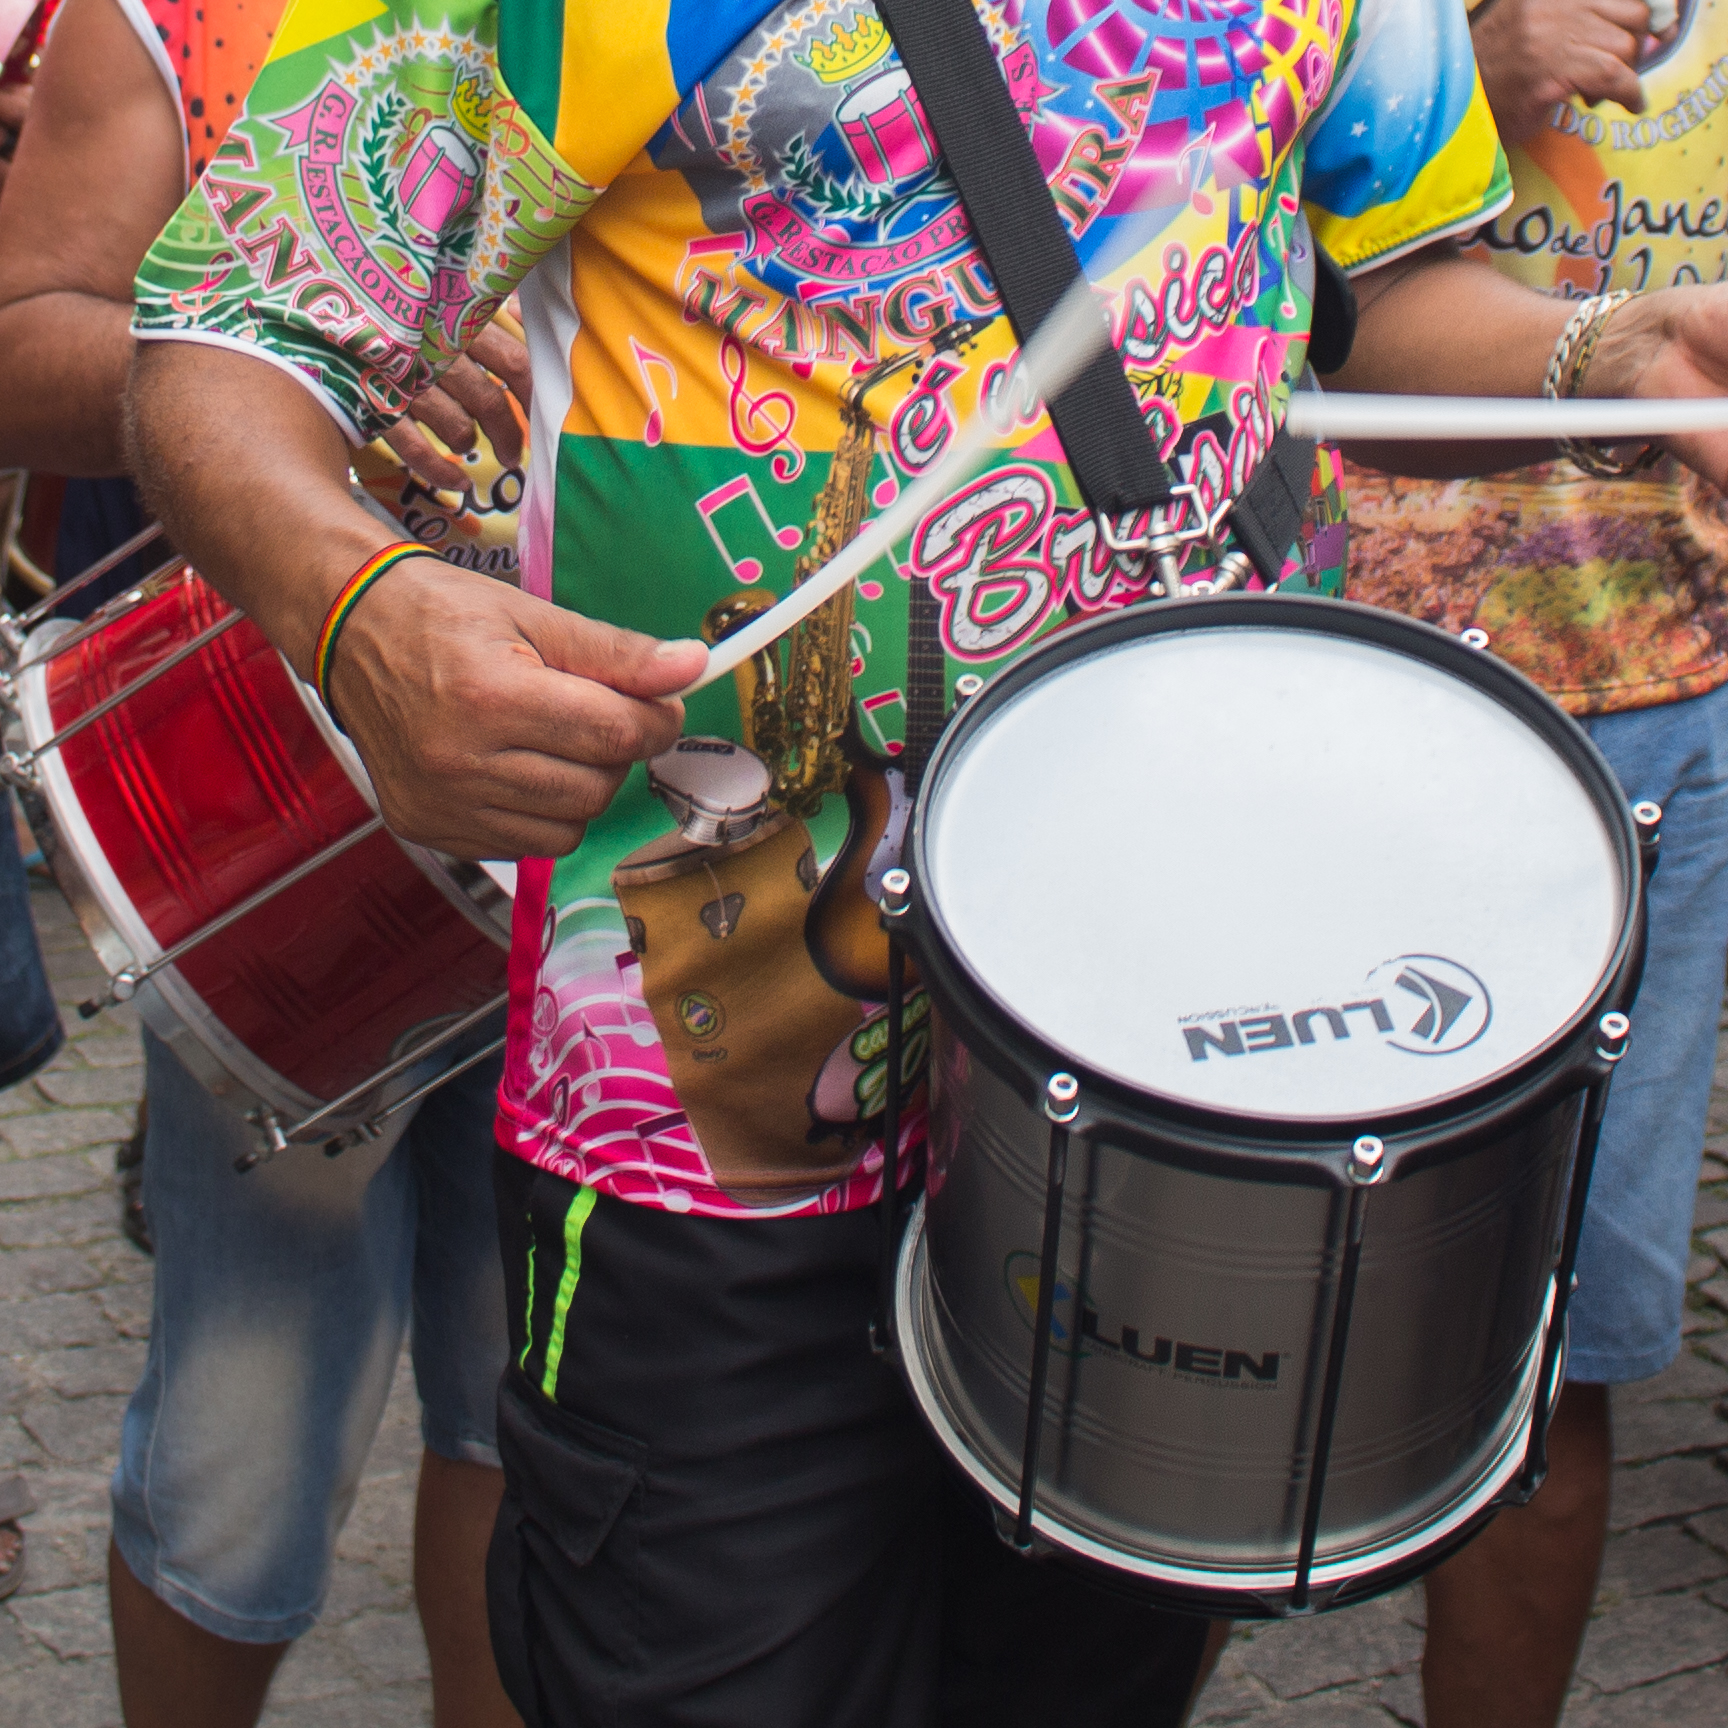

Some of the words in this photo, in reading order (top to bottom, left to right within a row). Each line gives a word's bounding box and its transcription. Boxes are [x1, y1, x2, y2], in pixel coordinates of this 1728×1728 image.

[1550, 101, 1605, 146] DO
[306, 165, 381, 291] ESTAÇÃO
[686, 68, 1162, 364] MANGUIRA
[788, 240, 923, 278] ESTAÇÃO
[894, 362, 964, 474] é
[1182, 998, 1395, 1062] LUEN
[1081, 1308, 1280, 1381] LUEN
